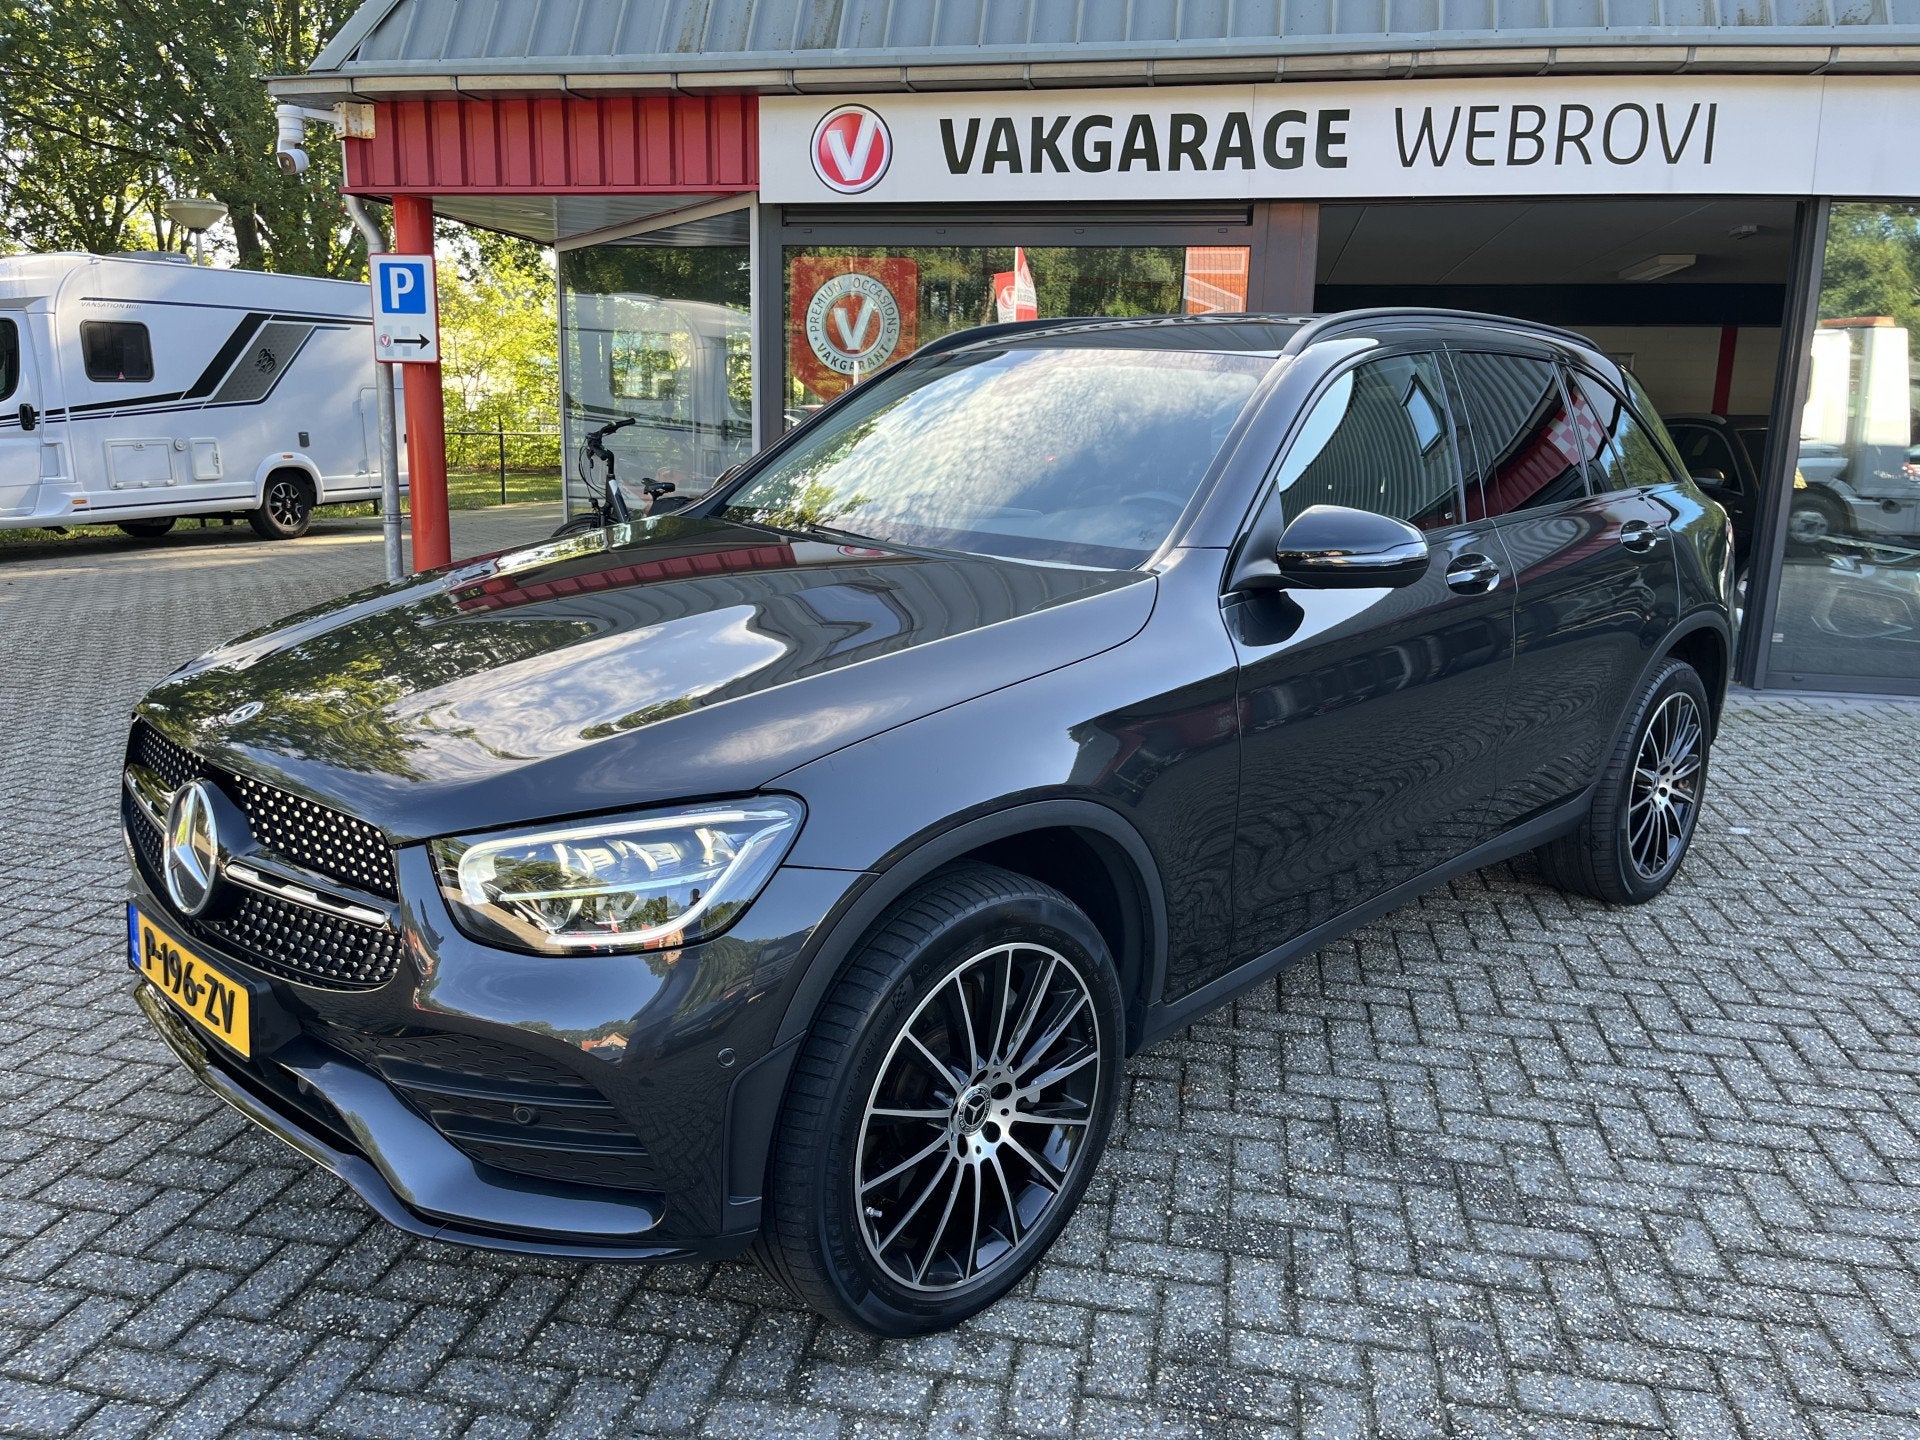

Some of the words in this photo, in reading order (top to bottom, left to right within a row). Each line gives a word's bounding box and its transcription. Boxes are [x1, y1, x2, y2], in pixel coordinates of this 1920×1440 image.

[939, 108, 1350, 174] VAKGARAGE
[1395, 102, 1717, 168] WEBROVI
[389, 267, 414, 309] P
[810, 281, 843, 333] PREMIUM
[853, 278, 897, 334] OCCASIONS
[817, 343, 889, 371] VAKGARANT
[144, 927, 235, 1034] P-196-ZV
